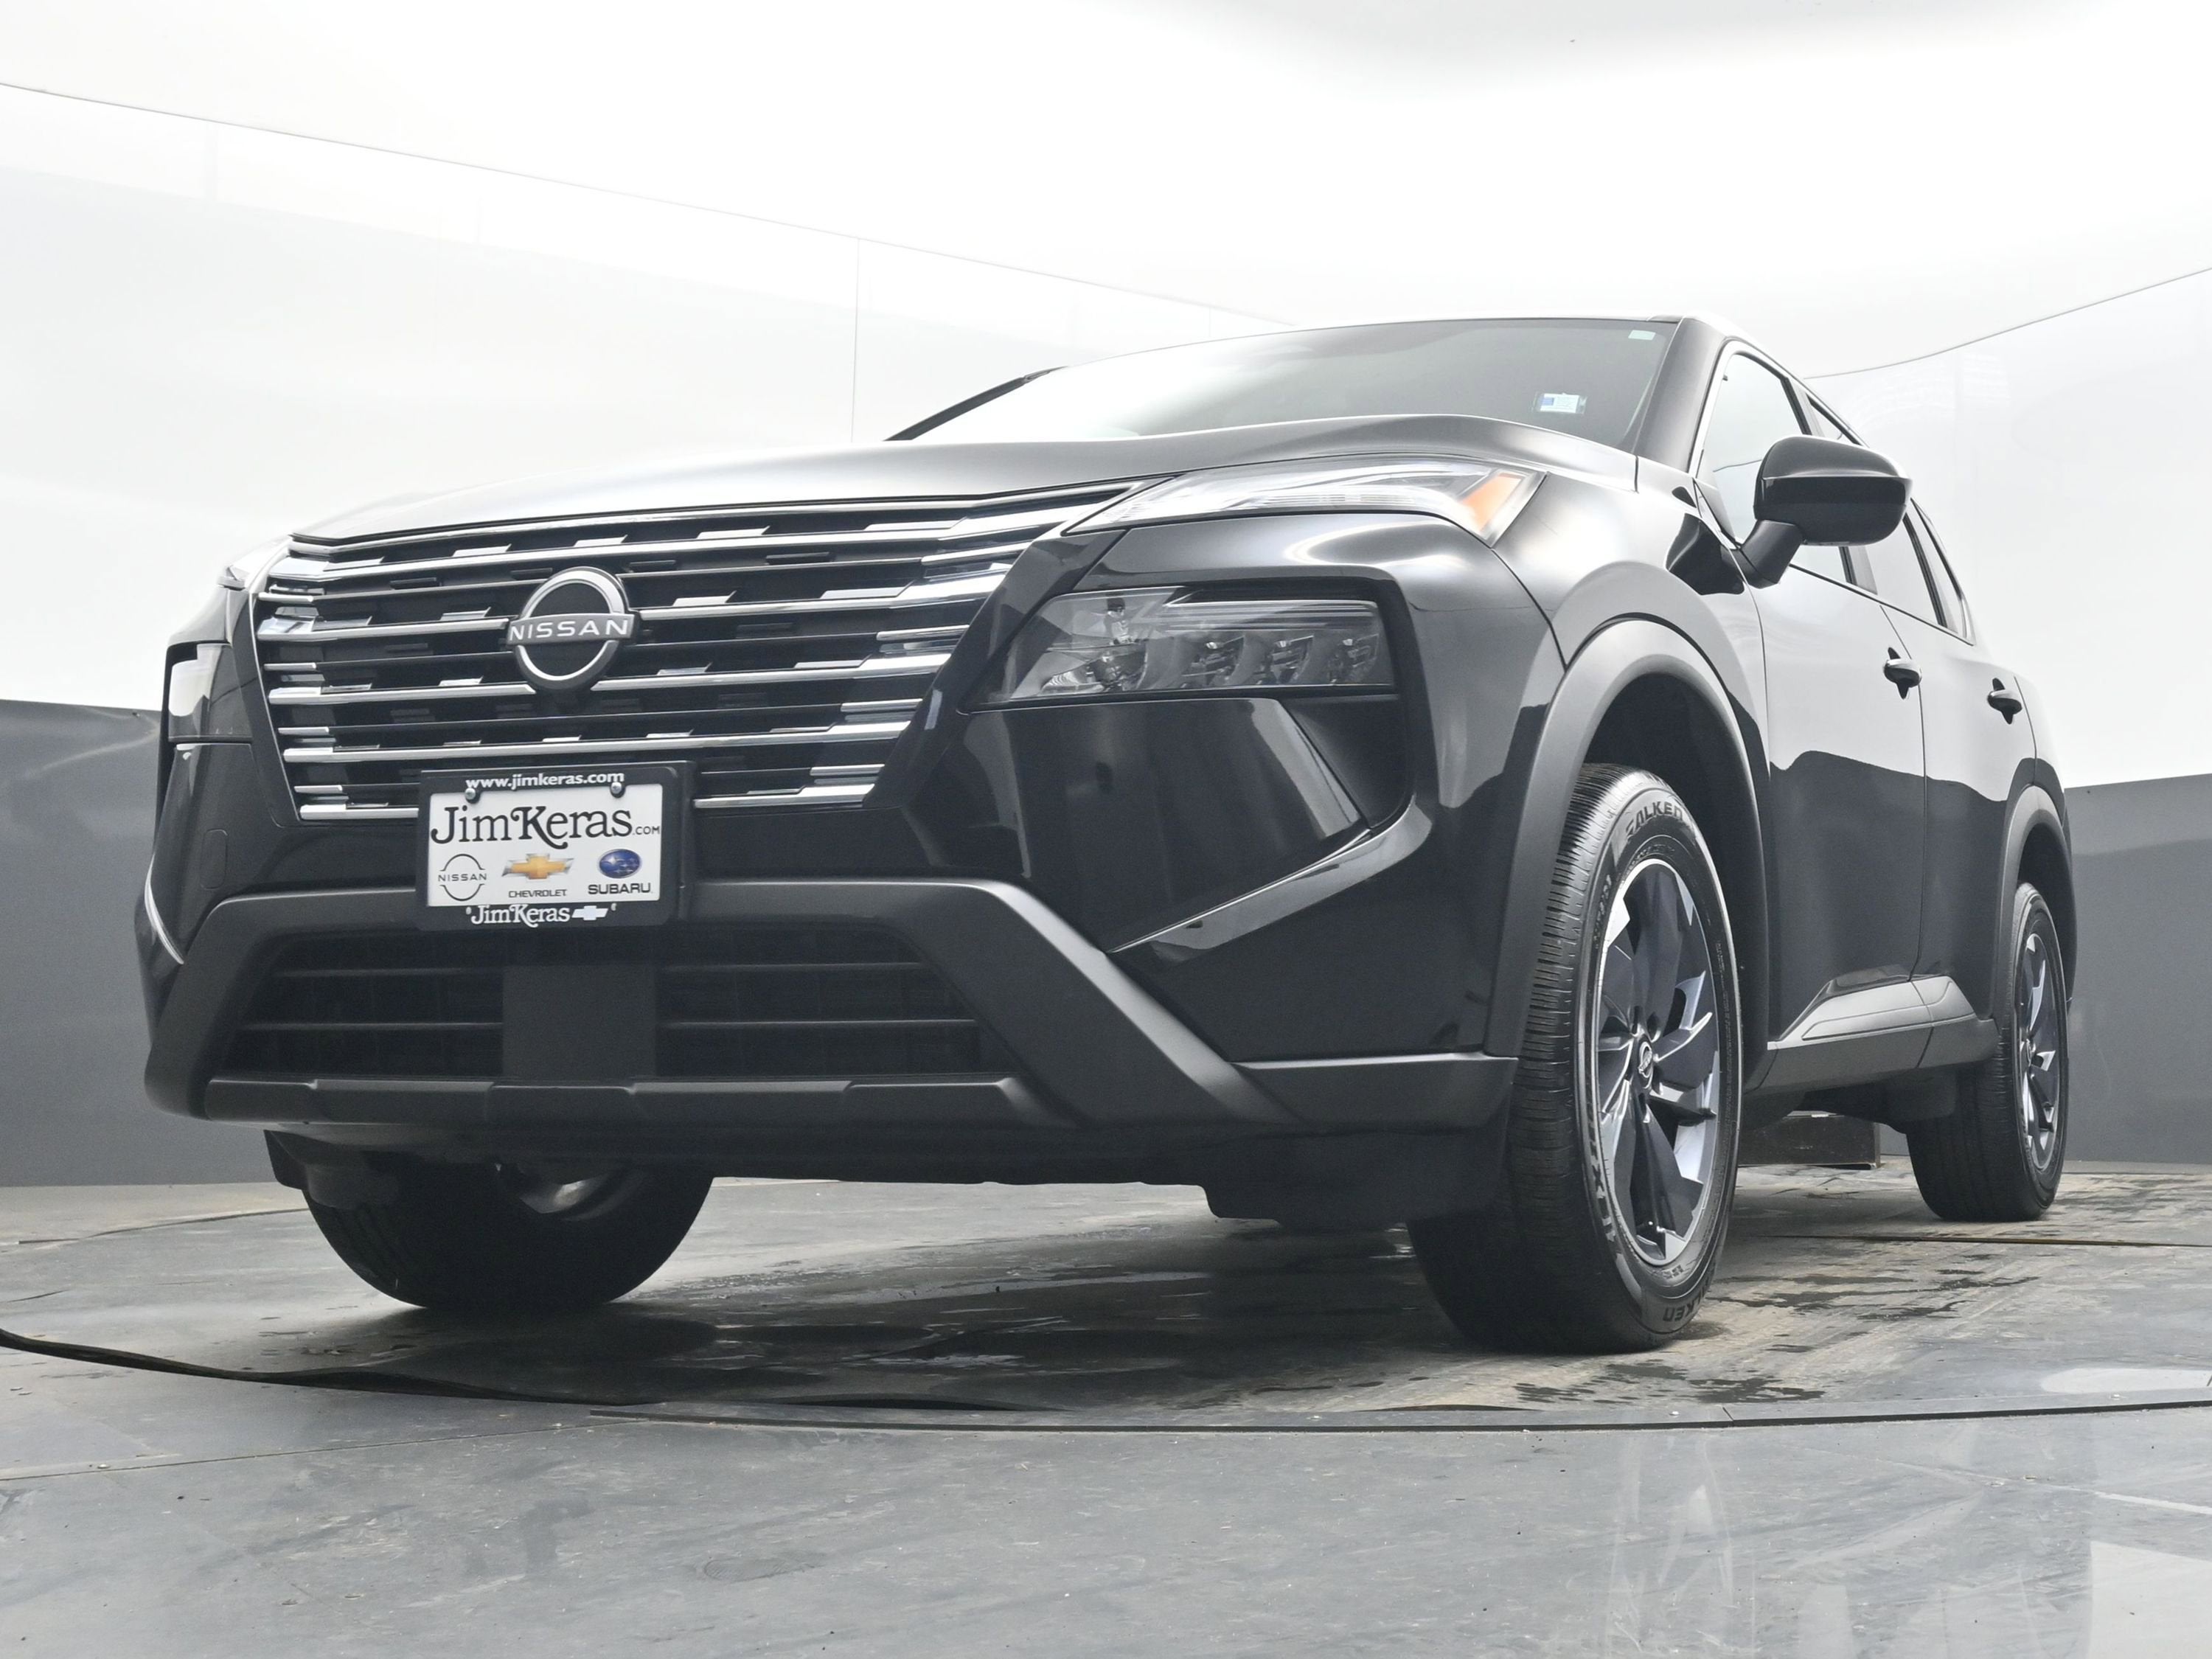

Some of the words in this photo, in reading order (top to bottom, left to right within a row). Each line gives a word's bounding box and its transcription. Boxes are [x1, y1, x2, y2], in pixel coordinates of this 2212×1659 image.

[509, 619, 628, 641] NISSAN
[465, 773, 625, 790] www.jimkeras.com
[1624, 801, 1684, 836] FALKEN
[438, 873, 487, 882] NISSAN
[508, 888, 568, 898] CHEVROLET
[588, 883, 651, 894] SUBARU
[470, 904, 571, 928] JimKeras
